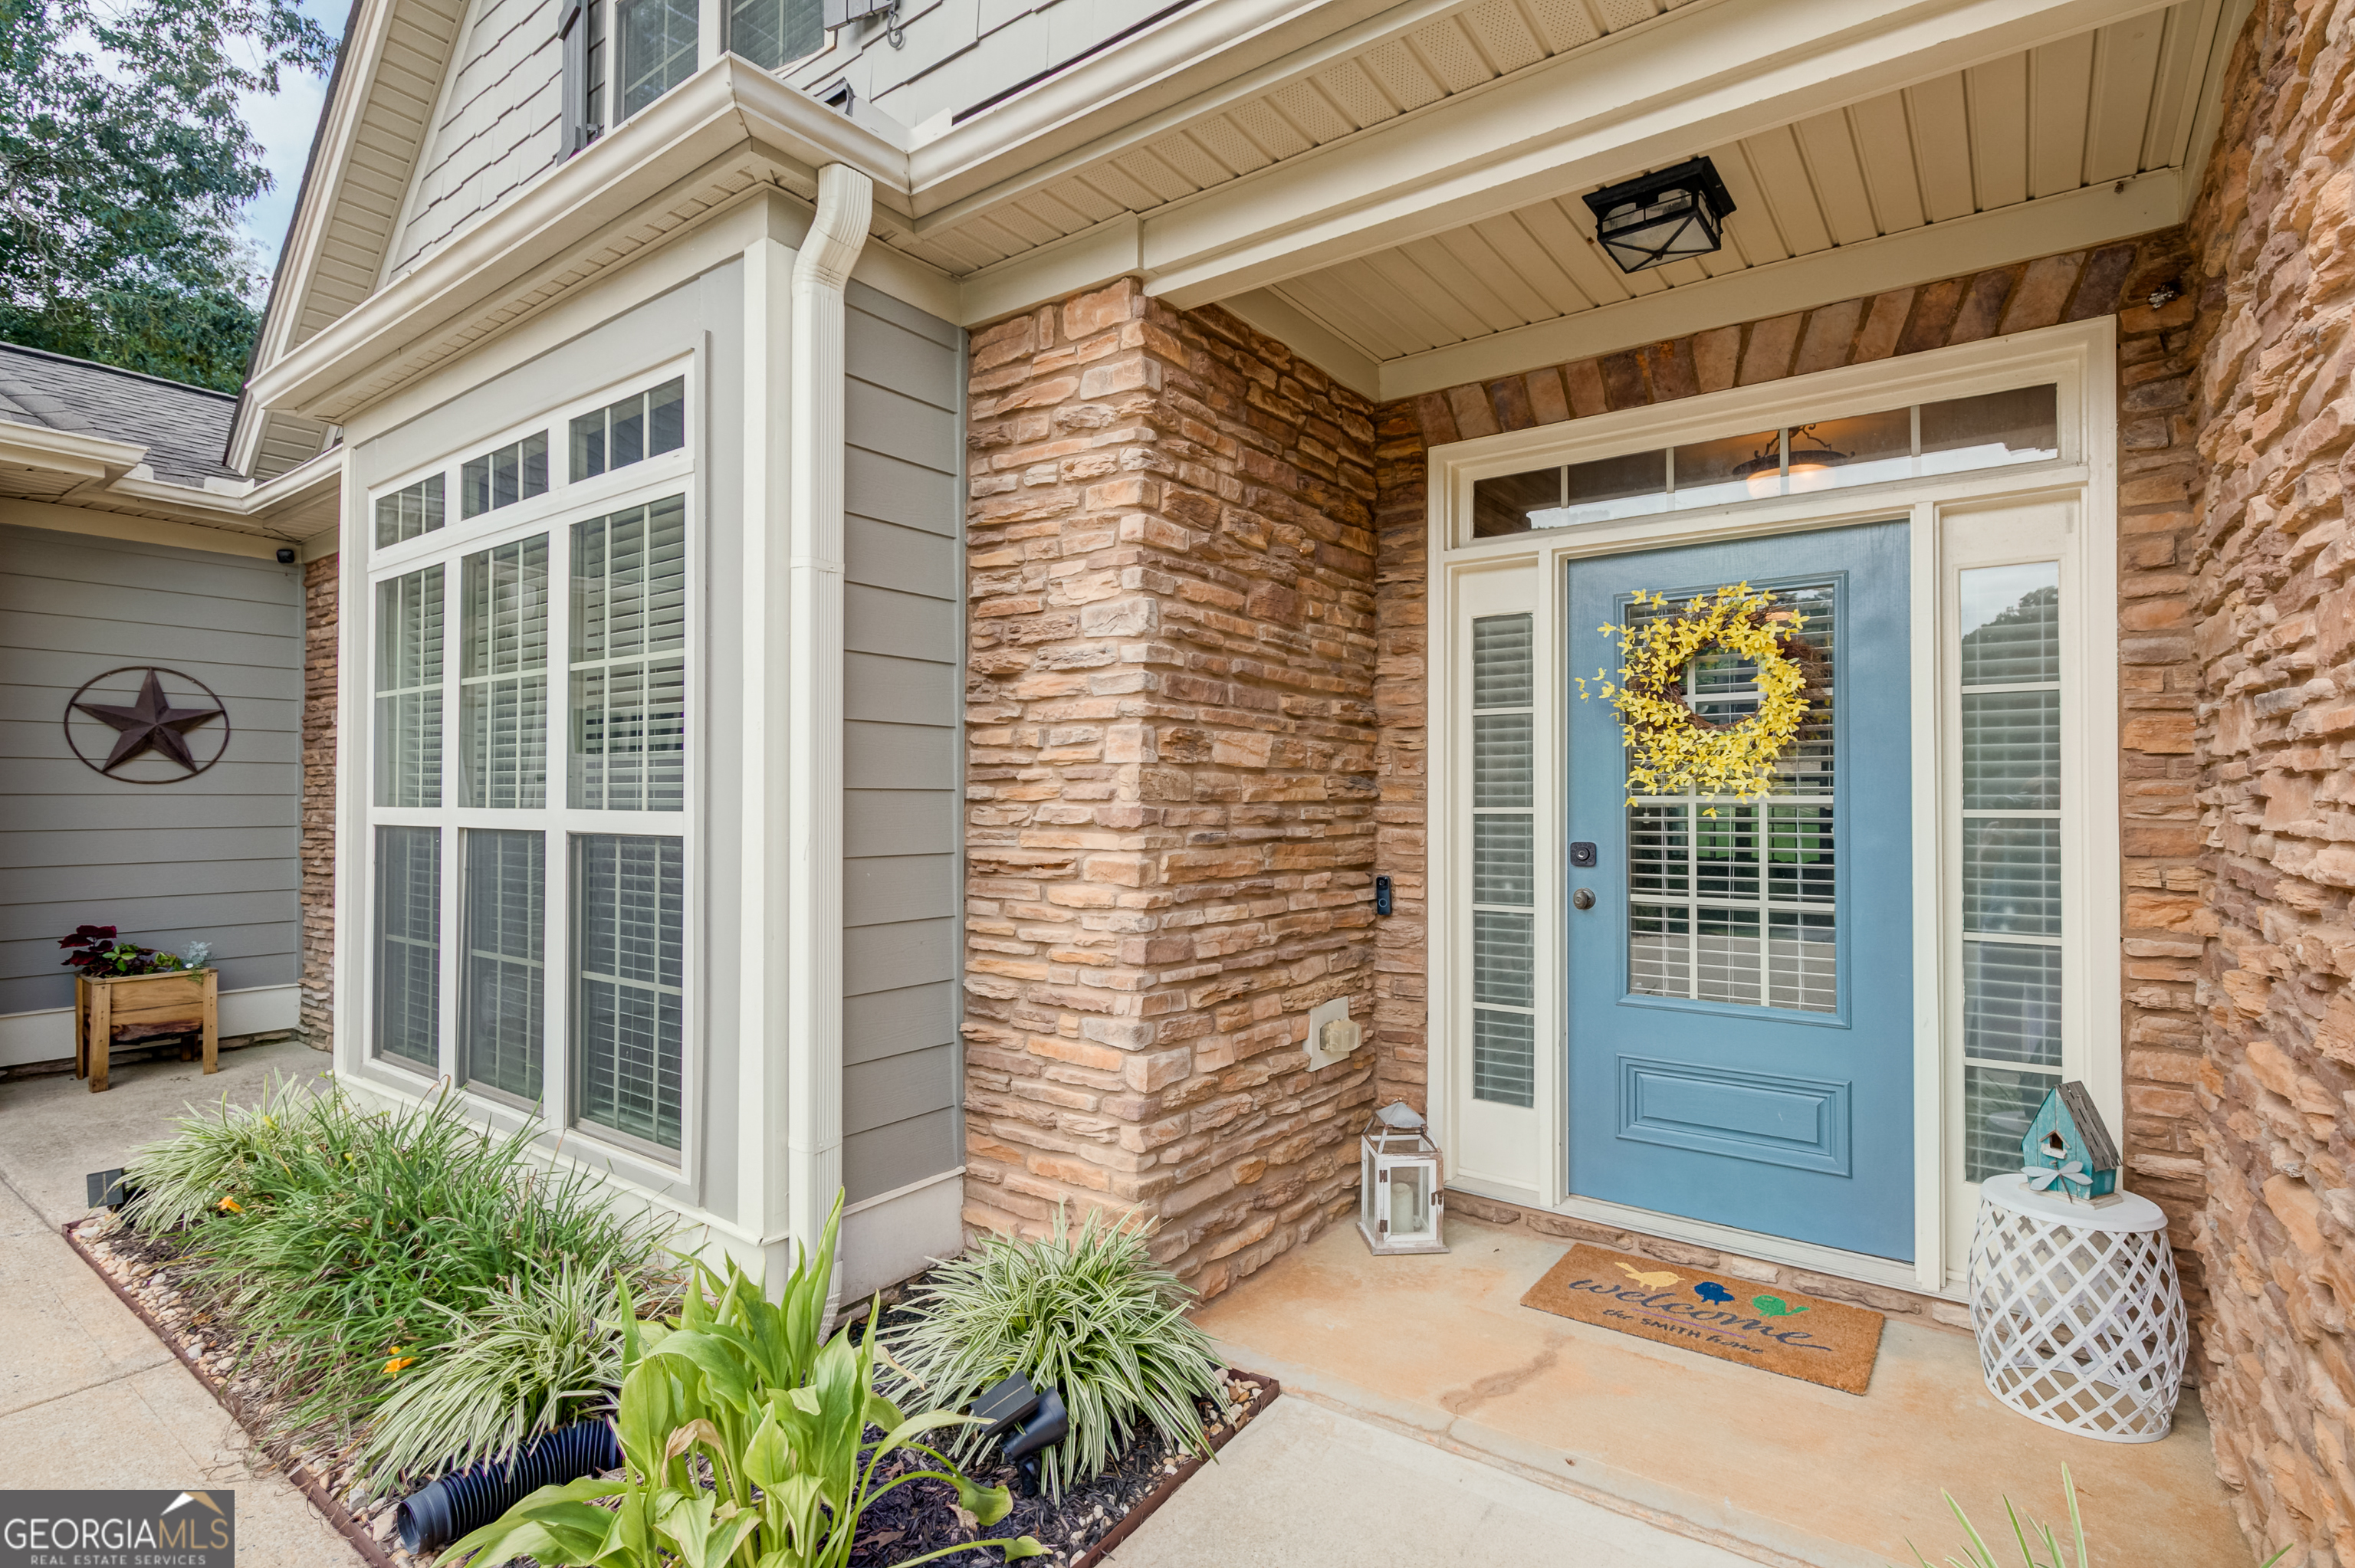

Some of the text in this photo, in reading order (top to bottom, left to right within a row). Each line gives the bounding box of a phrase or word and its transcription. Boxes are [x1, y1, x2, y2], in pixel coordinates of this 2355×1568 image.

[1568, 1279, 1833, 1352] welcome
[1641, 1317, 1701, 1338] SMITH
[1706, 1335, 1764, 1354] home
